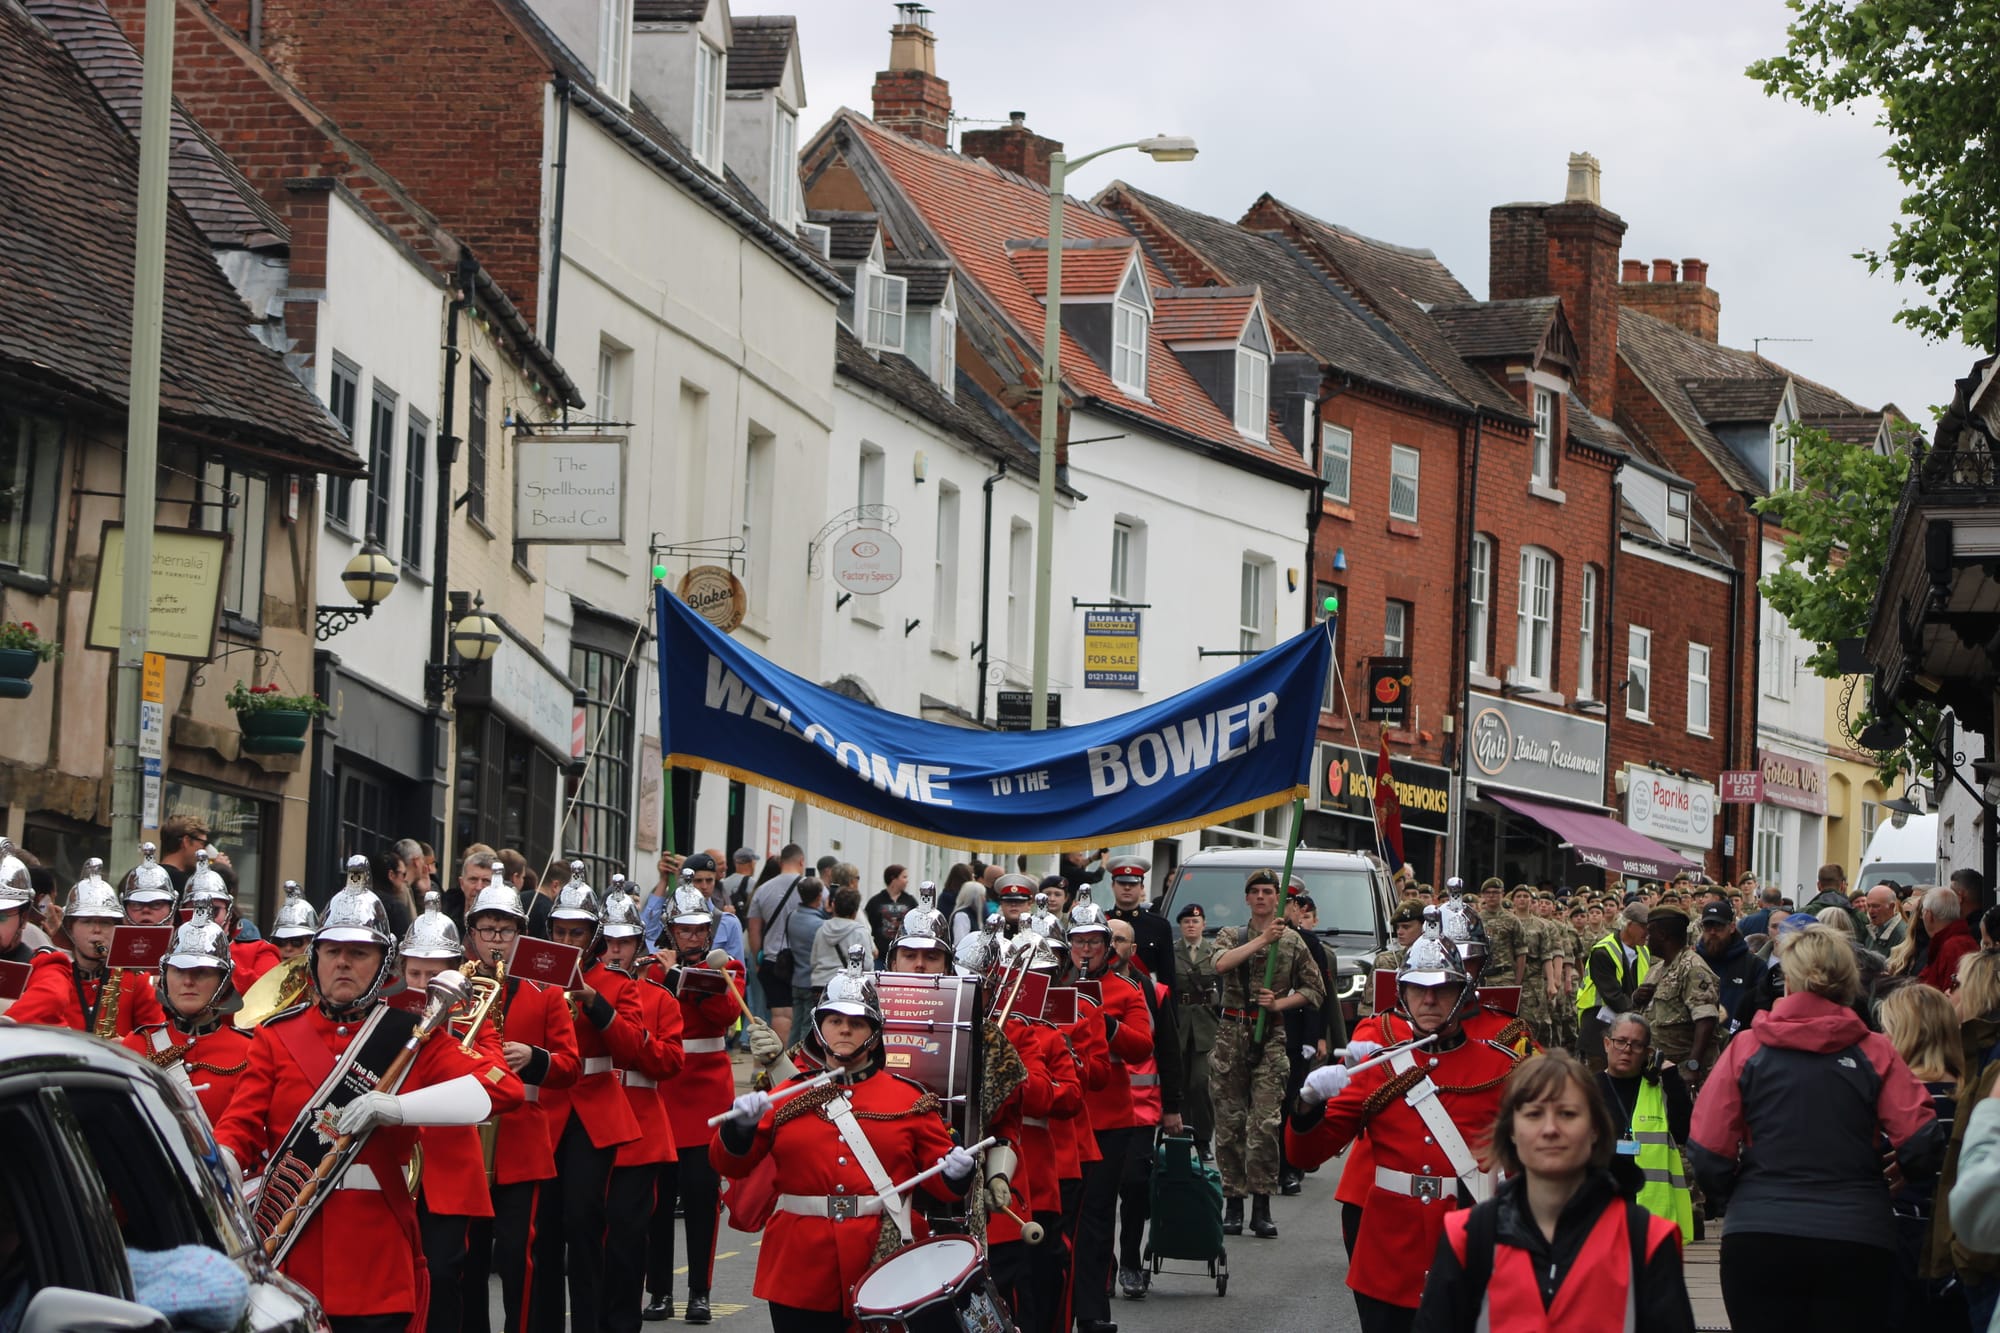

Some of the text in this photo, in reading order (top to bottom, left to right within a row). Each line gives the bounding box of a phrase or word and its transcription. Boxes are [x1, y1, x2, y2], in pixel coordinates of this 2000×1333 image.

[553, 456, 588, 472] The
[524, 481, 616, 500] Spellbound
[532, 508, 608, 526] Bead Co
[841, 570, 897, 582] Factory Specs
[687, 587, 734, 609] Blokes
[1088, 655, 1136, 665] FOR SALE
[989, 778, 1012, 797] TO
[1018, 771, 1050, 793] THE
[1087, 691, 1279, 797] BOWER
[1479, 731, 1506, 766] Goli
[1513, 735, 1600, 775] Italian Restaurant
[1726, 773, 1757, 785] JUST
[1763, 759, 1797, 787] Golden
[1350, 773, 1366, 797] BIG
[1394, 782, 1448, 813] FIREWORKS
[1653, 780, 1689, 812] Paprika
[1733, 785, 1757, 797] EAT
[893, 1009, 935, 1017] SERVICE
[353, 1061, 367, 1075] The
